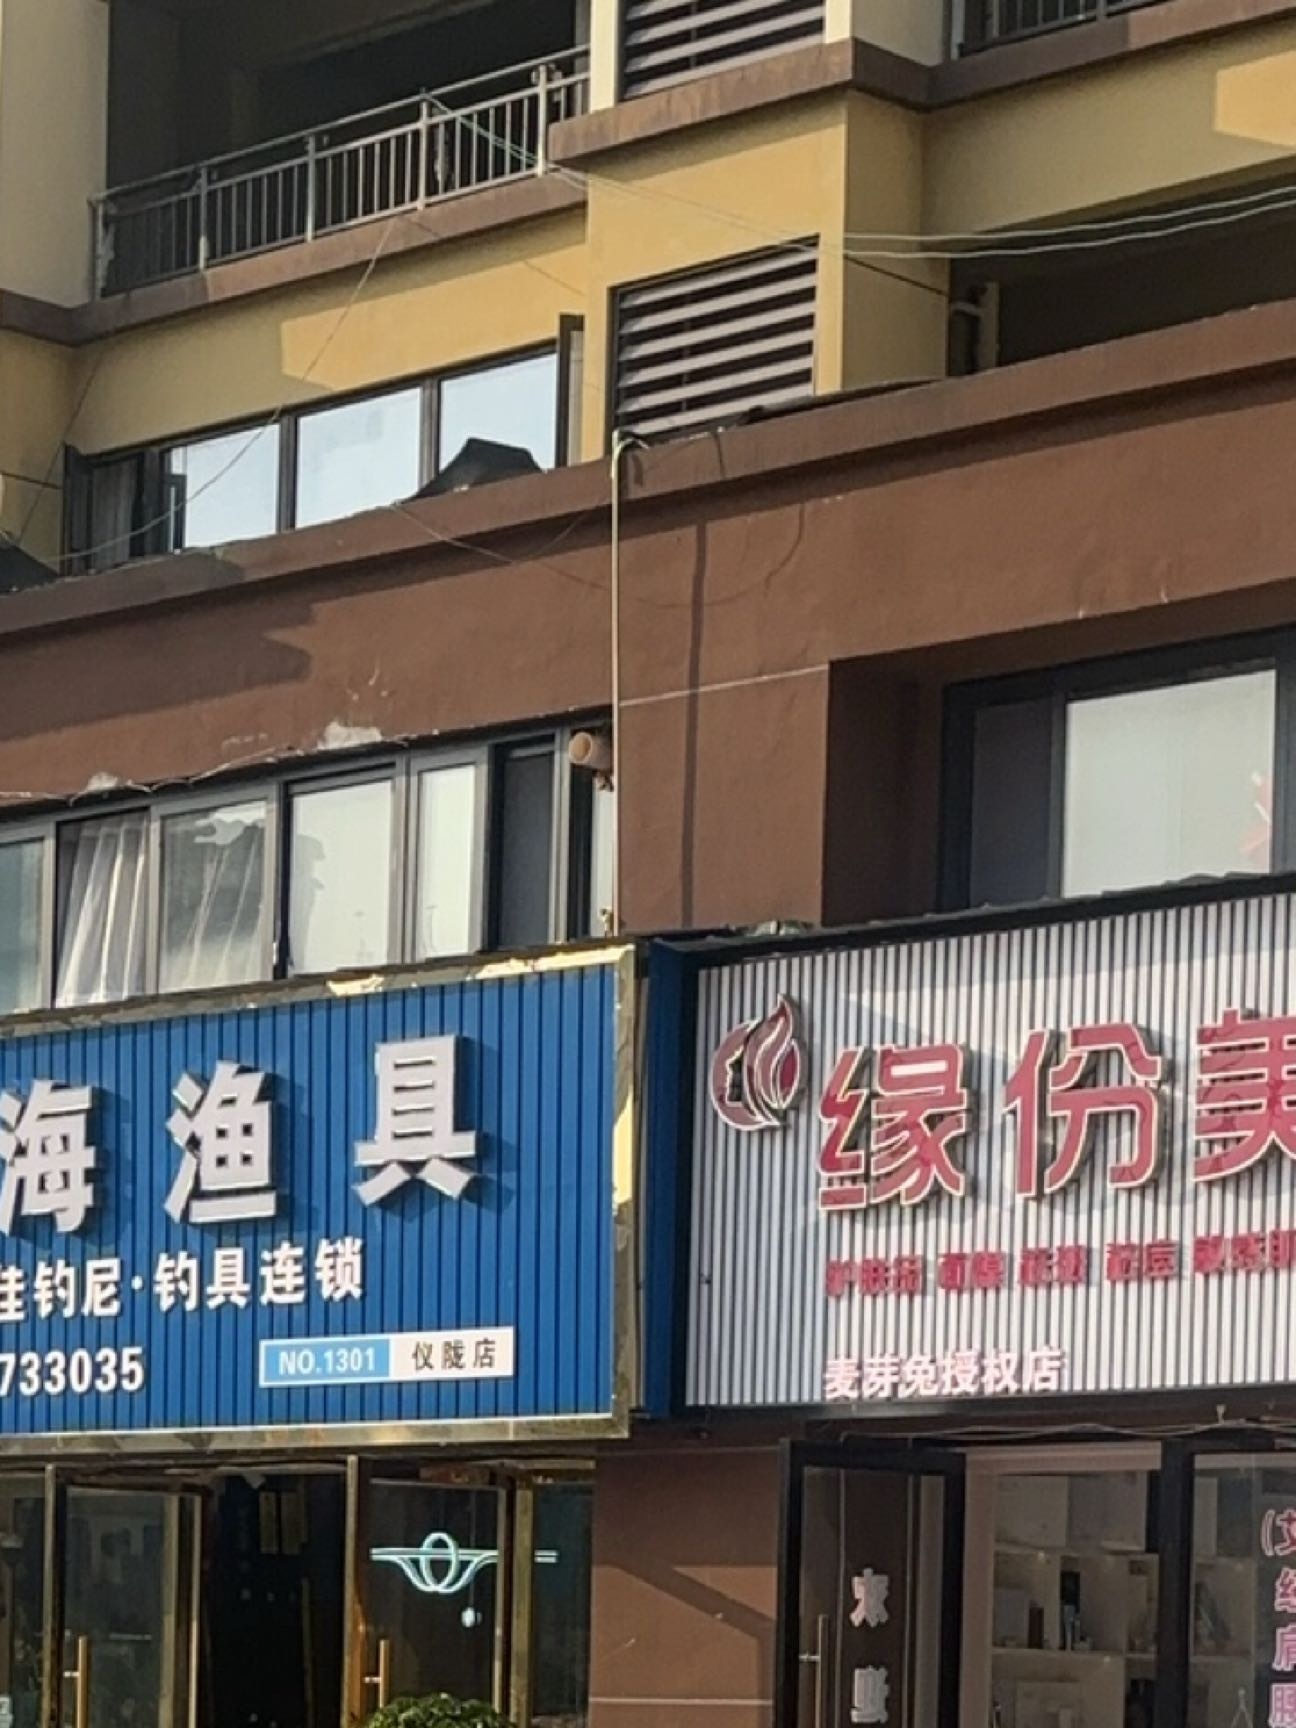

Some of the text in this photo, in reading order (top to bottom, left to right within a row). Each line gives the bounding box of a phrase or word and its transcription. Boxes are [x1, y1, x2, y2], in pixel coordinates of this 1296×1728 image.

[278, 1347, 375, 1376] NO.1301
[412, 1338, 496, 1371] 仪陇店
